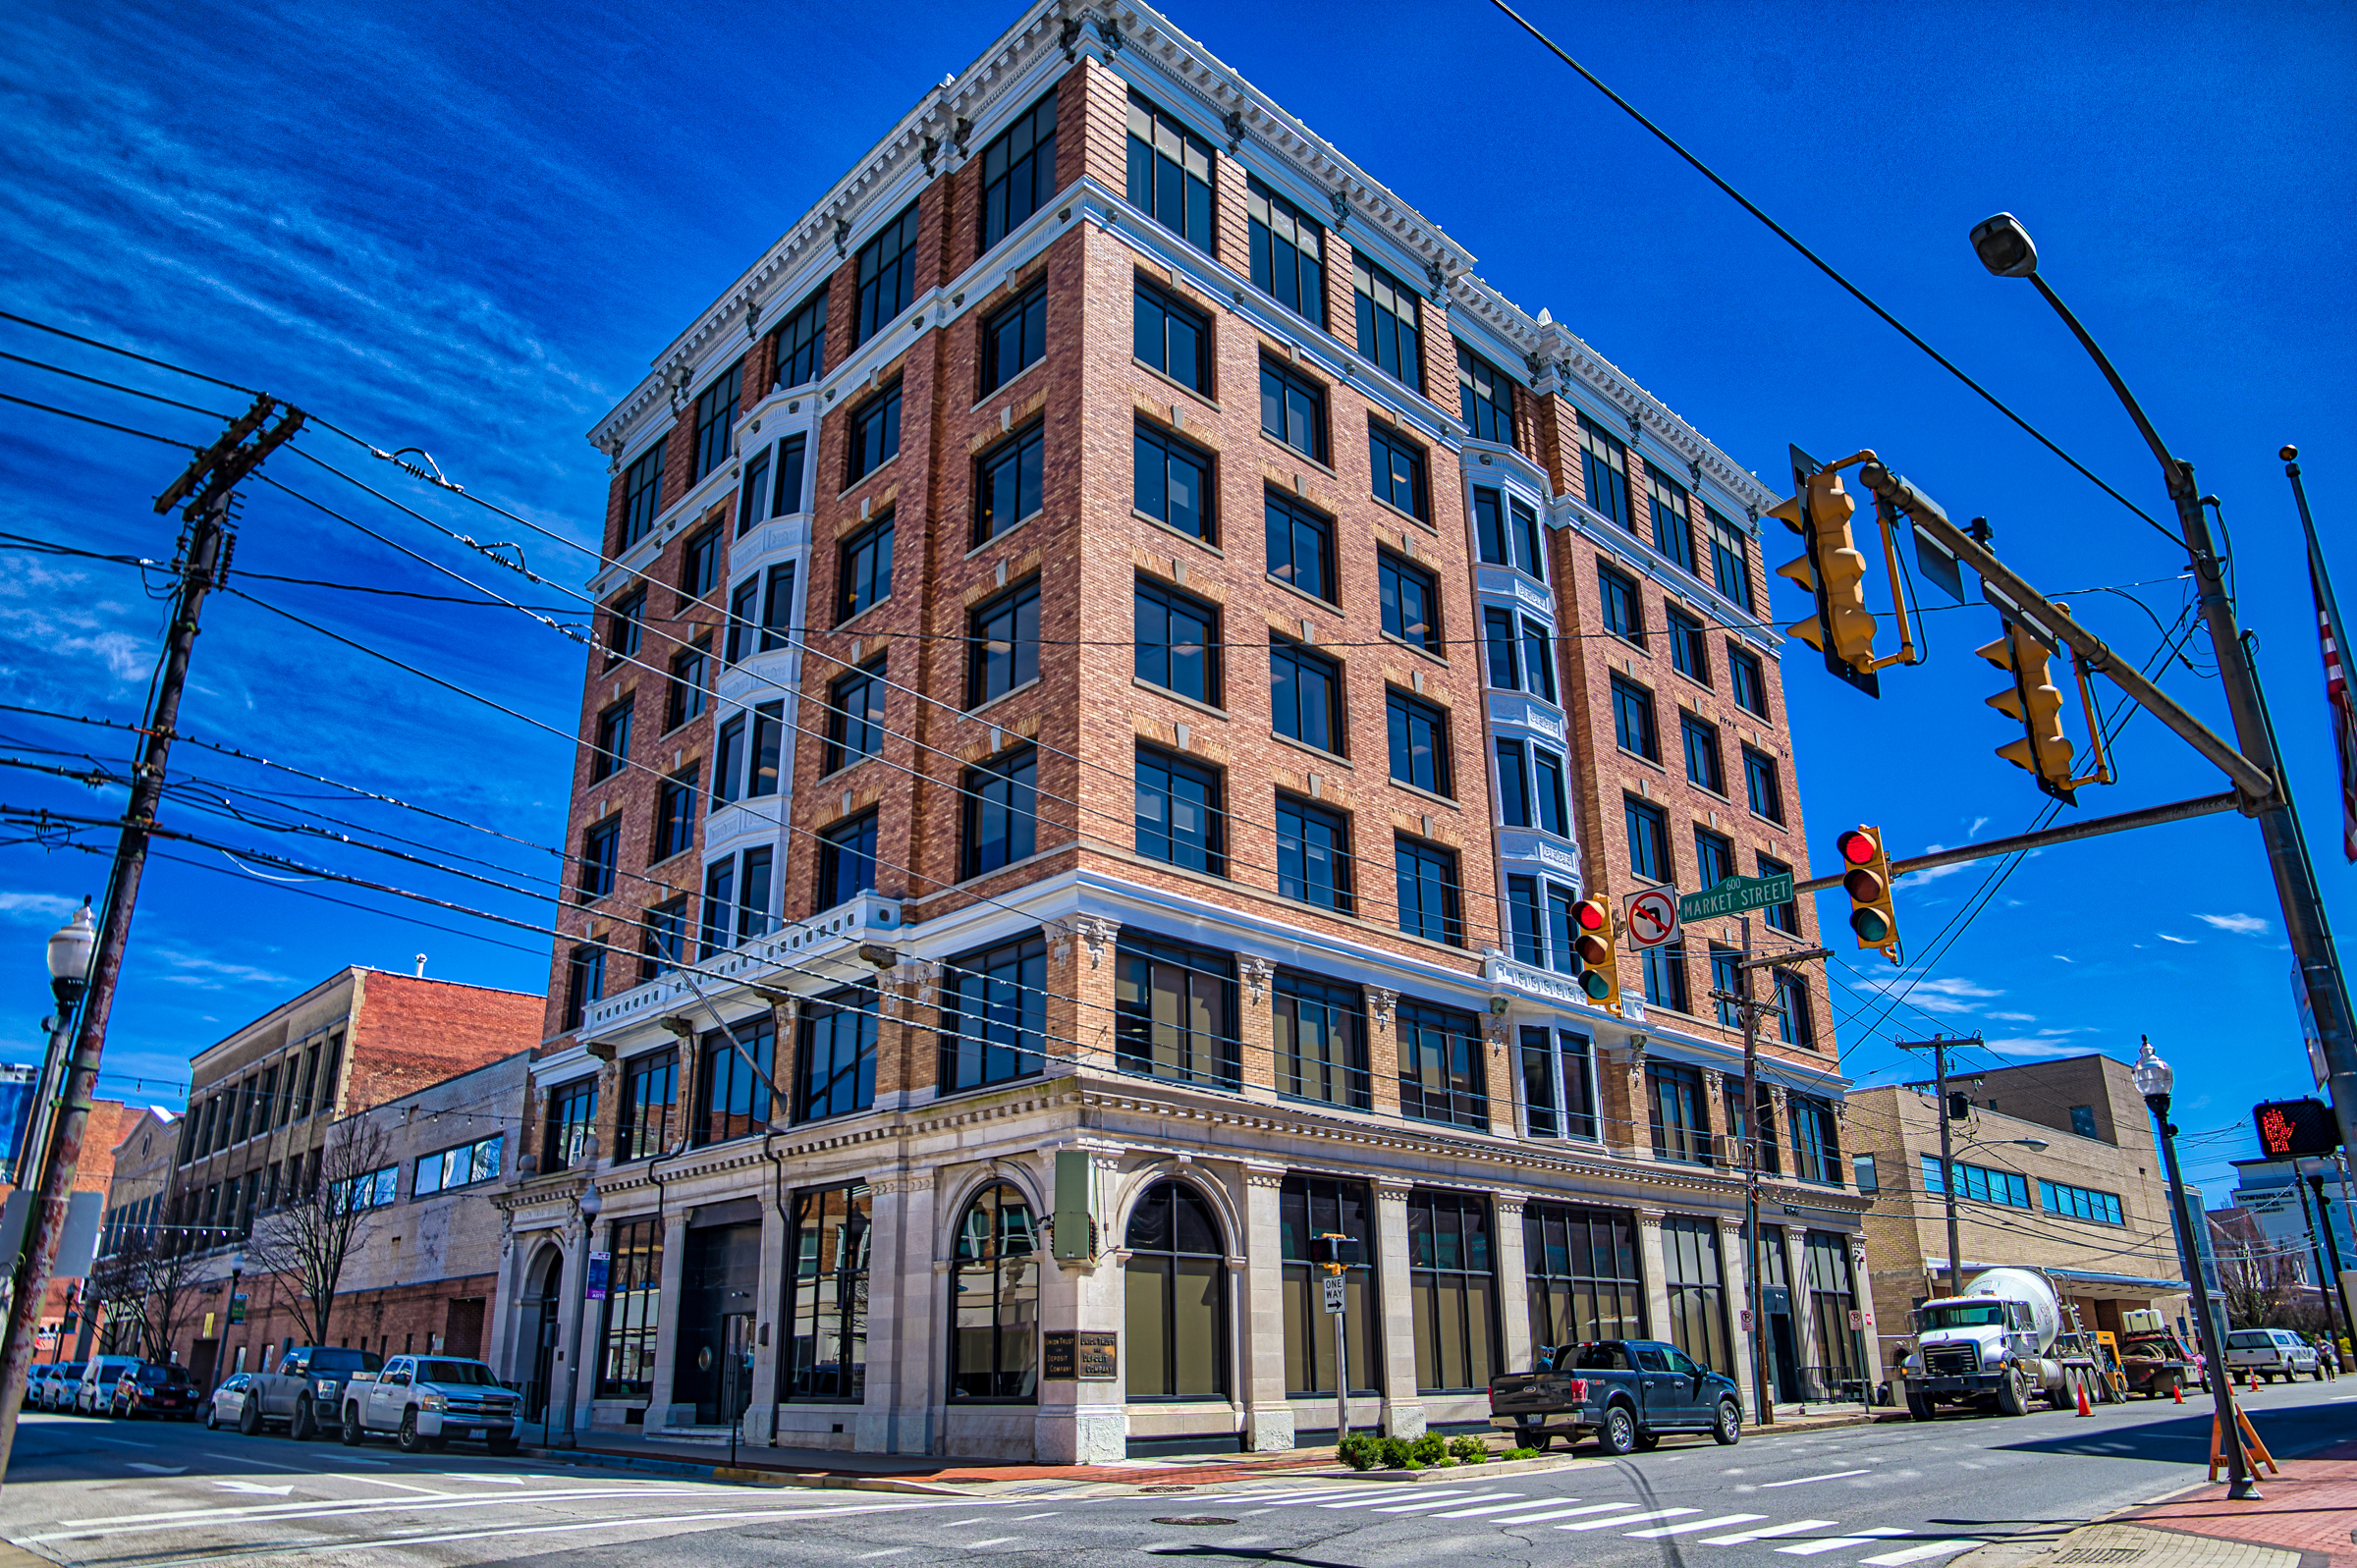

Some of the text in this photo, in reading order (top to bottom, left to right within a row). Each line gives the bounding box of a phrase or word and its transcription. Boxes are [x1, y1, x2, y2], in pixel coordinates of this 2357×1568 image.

[1726, 877, 1741, 892] 600
[1684, 881, 1786, 918] MARKET STREET
[2236, 1190, 2294, 1202] TOWNEPLACE
[1326, 1278, 1343, 1289] ONE
[1326, 1289, 1343, 1299] WAY
[1060, 1336, 1074, 1345] TRUST
[1080, 1336, 1115, 1346] UNION TRUST
[1082, 1354, 1108, 1363] DEPOSIT
[1086, 1364, 1113, 1374] COMPANY
